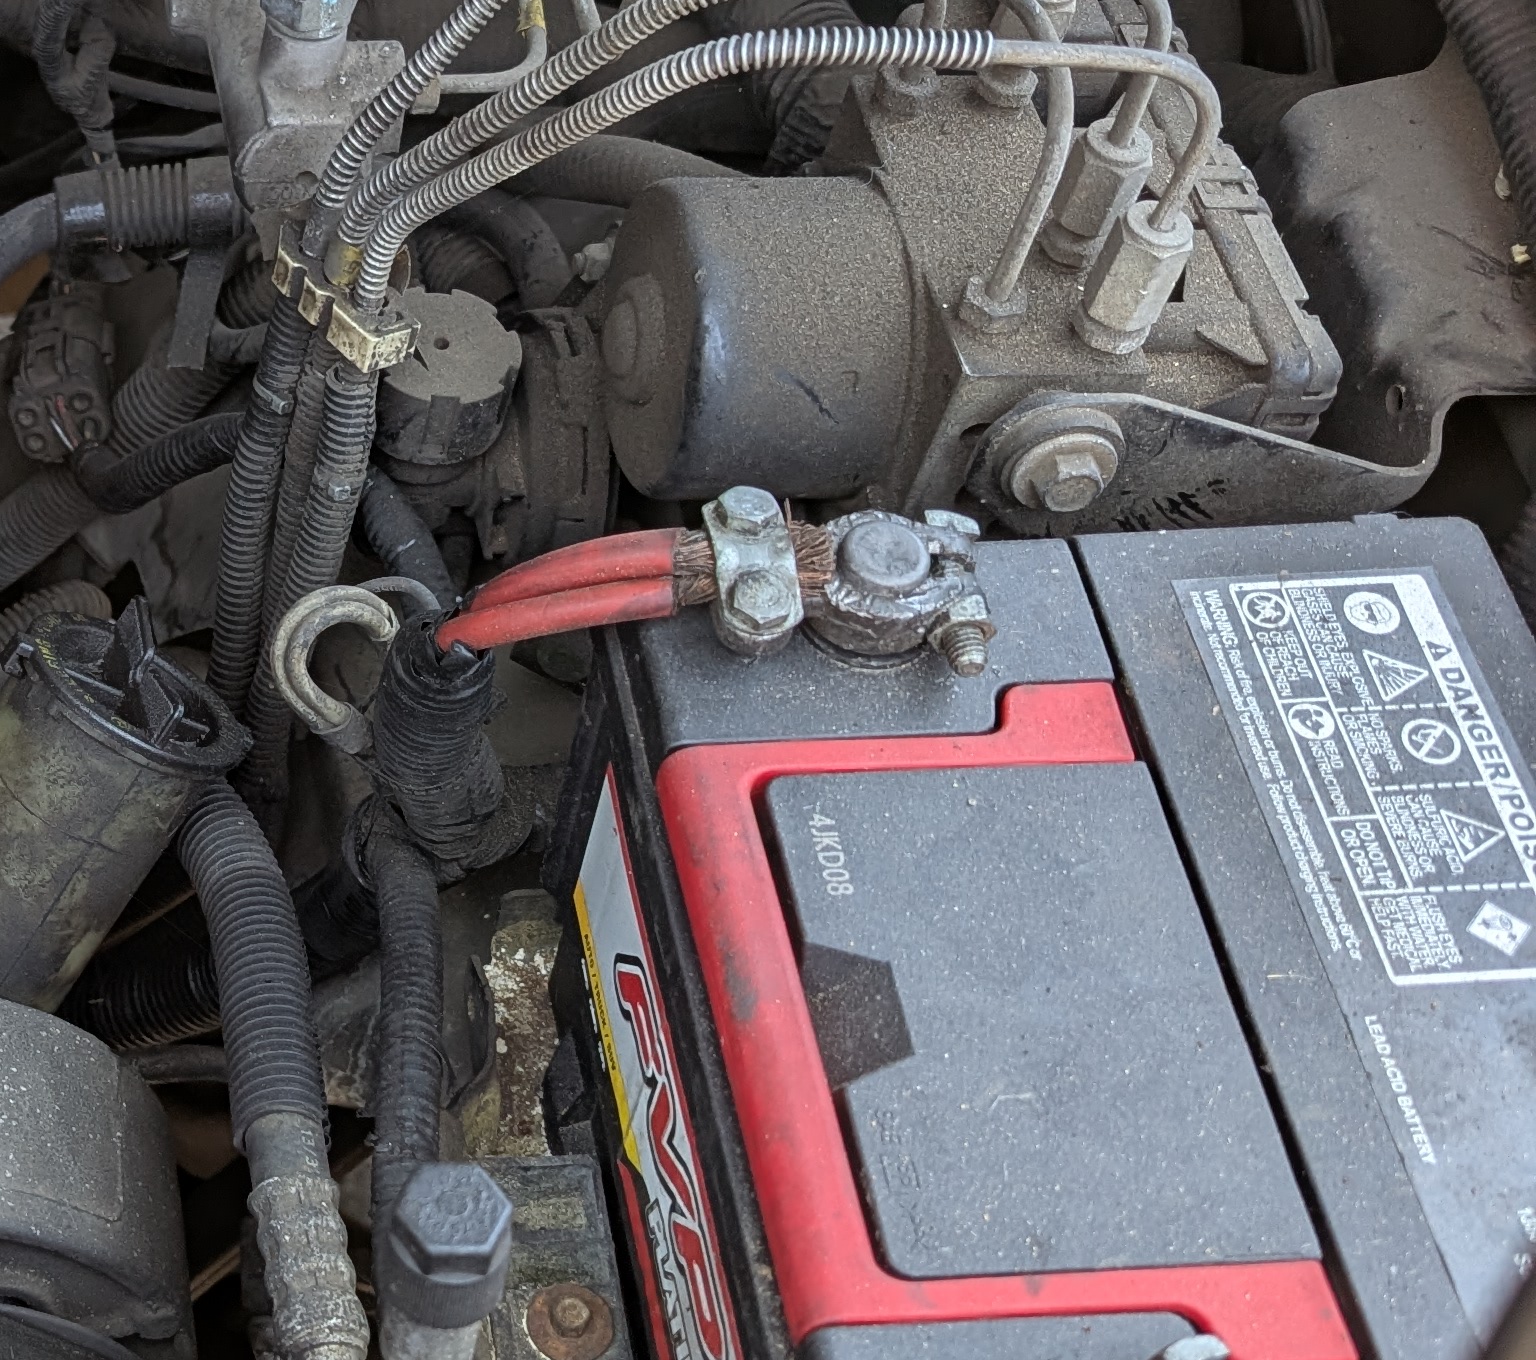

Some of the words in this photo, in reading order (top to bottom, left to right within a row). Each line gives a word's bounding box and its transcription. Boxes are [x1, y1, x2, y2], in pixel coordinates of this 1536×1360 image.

[1201, 589, 1240, 647] WARNING:
[1287, 588, 1320, 642] BLINDNESS
[1310, 643, 1327, 658] OR
[1300, 588, 1323, 620] GASES
[1314, 622, 1333, 642] CAN
[1324, 644, 1349, 678] CAUSE
[1205, 632, 1223, 648] Not
[1255, 631, 1271, 645] OF
[1268, 631, 1284, 644] OF
[1281, 630, 1302, 655] KEEP
[1293, 657, 1312, 678] OUT
[1312, 587, 1337, 621] SHIELD
[1340, 651, 1374, 706] EXPLOSIVE
[1225, 649, 1245, 668] Risk
[1234, 669, 1250, 679] of
[1261, 646, 1292, 696] CHILDREN
[1274, 646, 1299, 680] REACH
[1211, 648, 1248, 711] recommended
[1236, 712, 1254, 725] for
[1242, 695, 1273, 738] explosion
[1341, 714, 1358, 729] OR
[1353, 713, 1382, 754] FLAMES
[1366, 713, 1384, 728] NO
[1241, 725, 1268, 760] inverted
[1262, 739, 1276, 750] or
[1321, 739, 1344, 768] READ
[1278, 779, 1297, 793] Do
[1307, 740, 1351, 816] INSTRUCTIONS
[1265, 783, 1289, 813] Follow
[1284, 794, 1302, 809] not
[1275, 815, 1304, 851] product
[1354, 821, 1376, 839] DO
[1376, 795, 1406, 838] SEVERE
[1403, 794, 1425, 817] CAN
[1415, 819, 1443, 856] CAUSE
[1417, 793, 1452, 846] SULFURIC
[1338, 828, 1361, 847] OR
[1389, 795, 1428, 854] BLINDNESS
[1417, 856, 1437, 873] OR
[1289, 851, 1322, 892] charging
[1363, 841, 1388, 868] NOT
[1374, 869, 1398, 889] TIP
[1324, 892, 1349, 922] above
[1366, 897, 1391, 926] HELP
[1394, 895, 1418, 924] WITH
[1421, 894, 1448, 931] FLUSH
[1380, 897, 1402, 920] GET
[1391, 921, 1424, 972] MEDICAL
[1364, 1015, 1392, 1055] LEAD
[1381, 1056, 1408, 1093] ACID
[1397, 1094, 1437, 1166] BATTERY
